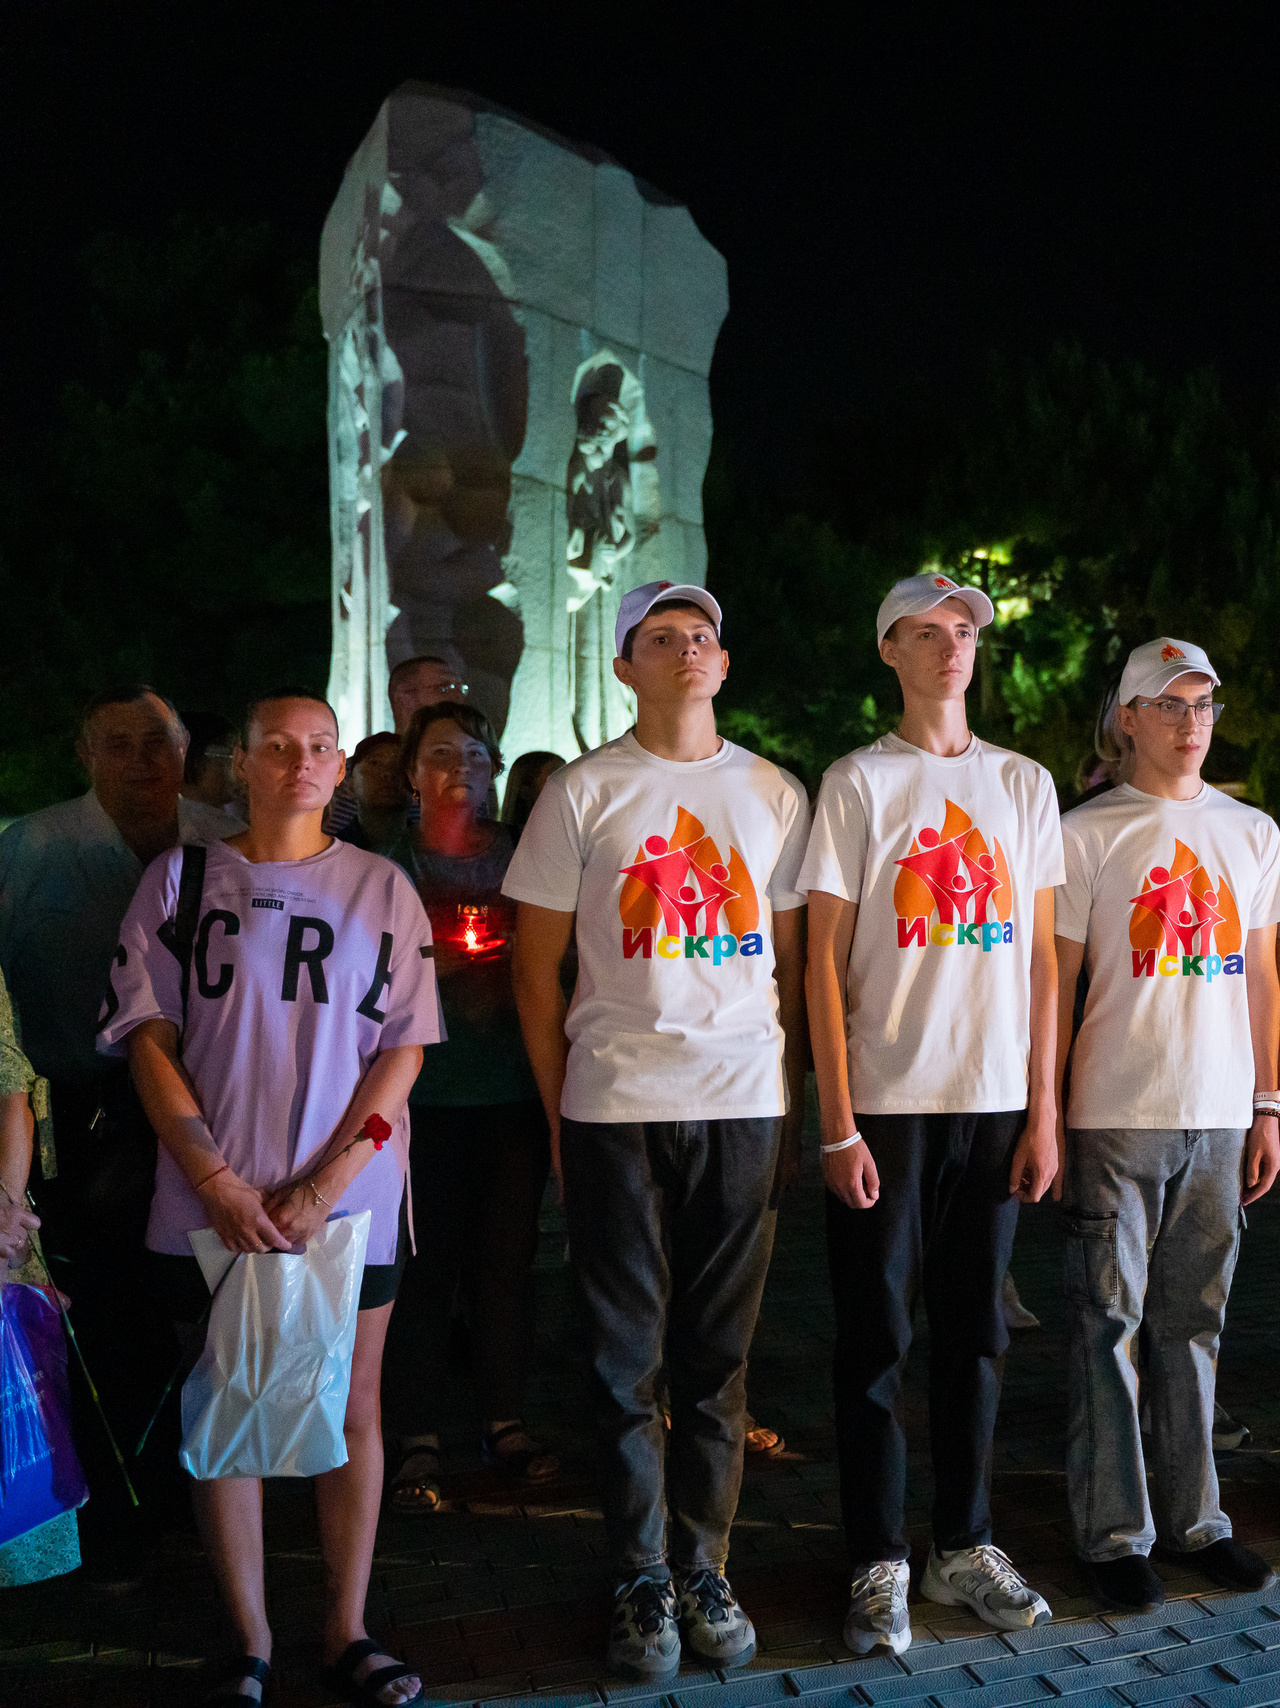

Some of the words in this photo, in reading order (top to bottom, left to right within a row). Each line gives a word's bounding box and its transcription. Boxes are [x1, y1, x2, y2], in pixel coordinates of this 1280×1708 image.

[254, 900, 281, 908] LITTLE
[622, 926, 763, 967] Искра
[896, 915, 1013, 953] Искра
[1131, 948, 1244, 984] Искра
